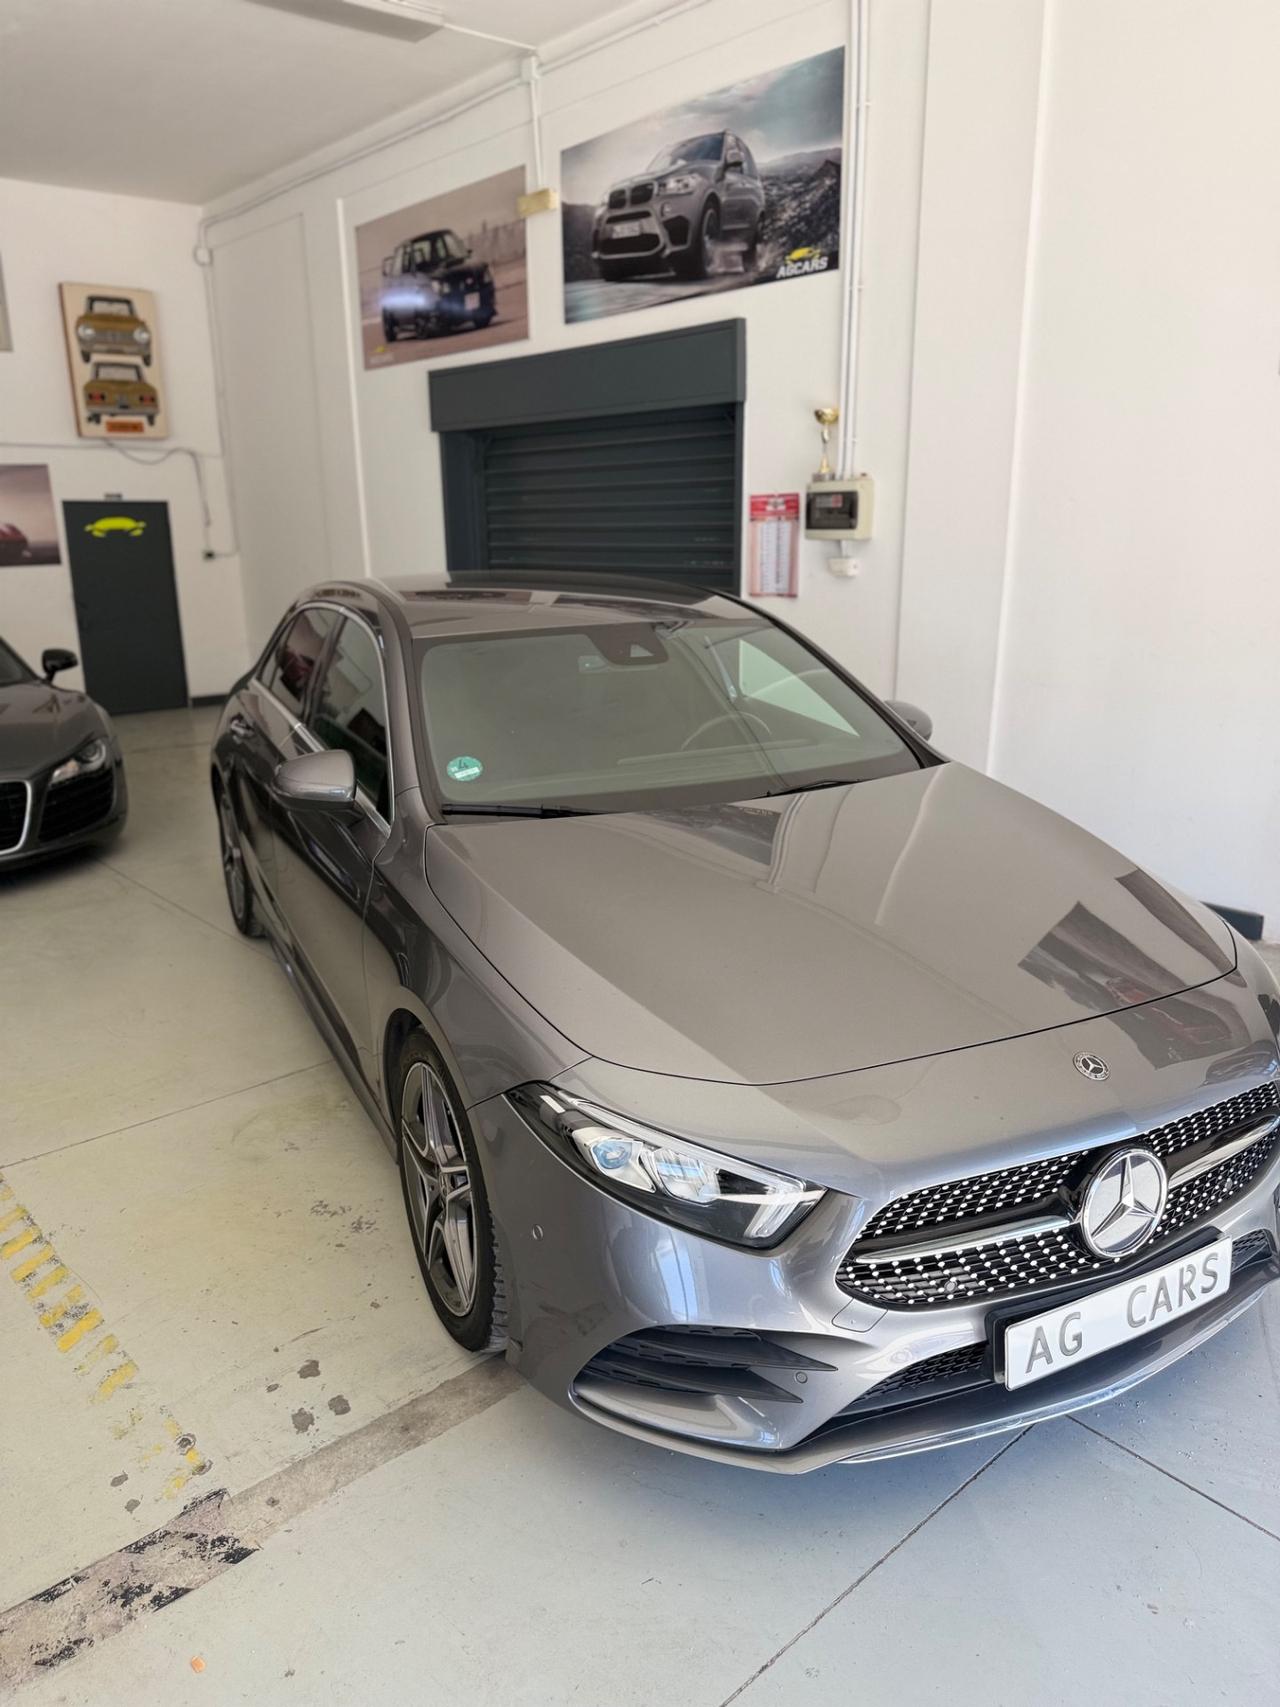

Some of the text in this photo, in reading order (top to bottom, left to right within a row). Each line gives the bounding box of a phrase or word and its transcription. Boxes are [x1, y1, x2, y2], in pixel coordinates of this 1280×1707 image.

[776, 256, 829, 279] AGCARS
[1025, 1252, 1220, 1374] AG CARS
